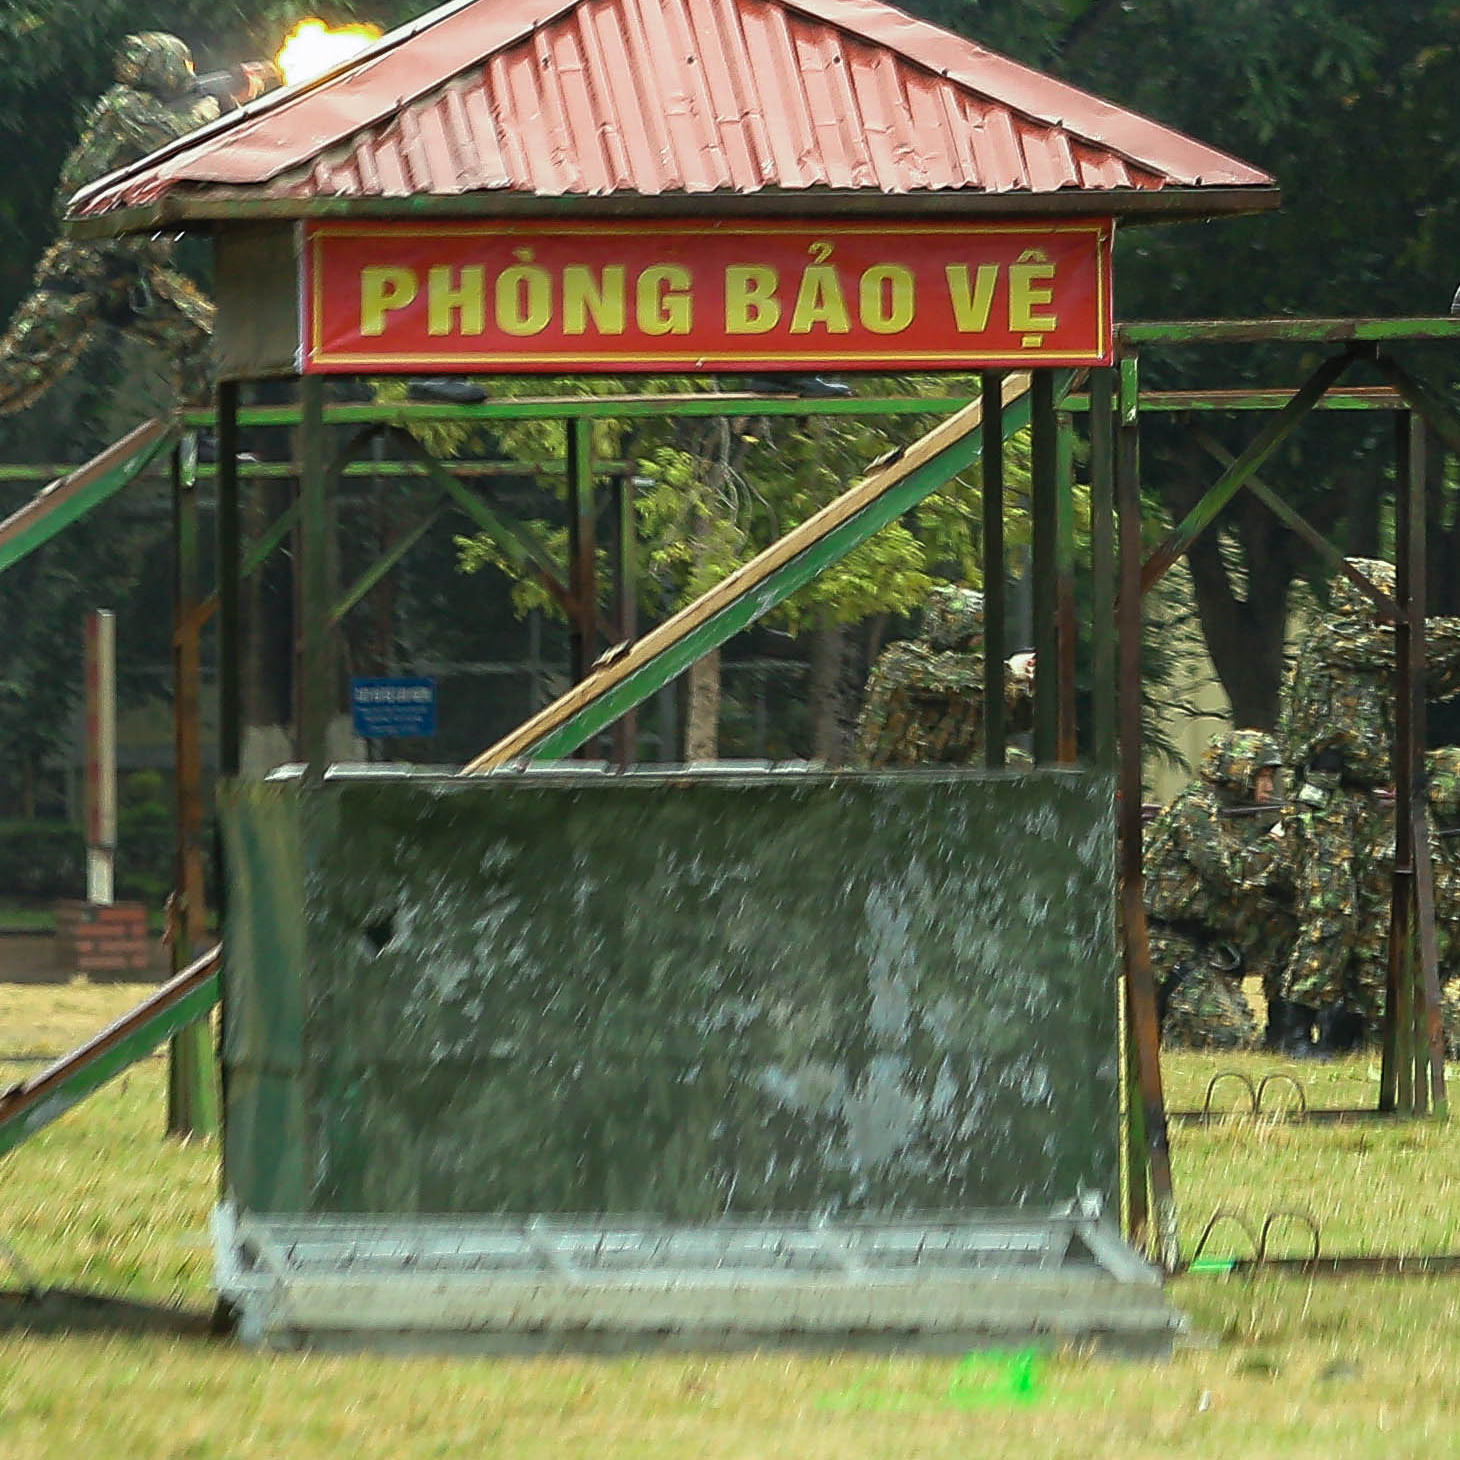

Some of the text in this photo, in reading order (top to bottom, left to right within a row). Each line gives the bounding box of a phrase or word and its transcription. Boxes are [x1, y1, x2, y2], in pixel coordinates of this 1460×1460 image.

[360, 242, 1058, 349] PHÒNG BẢO VỆ
